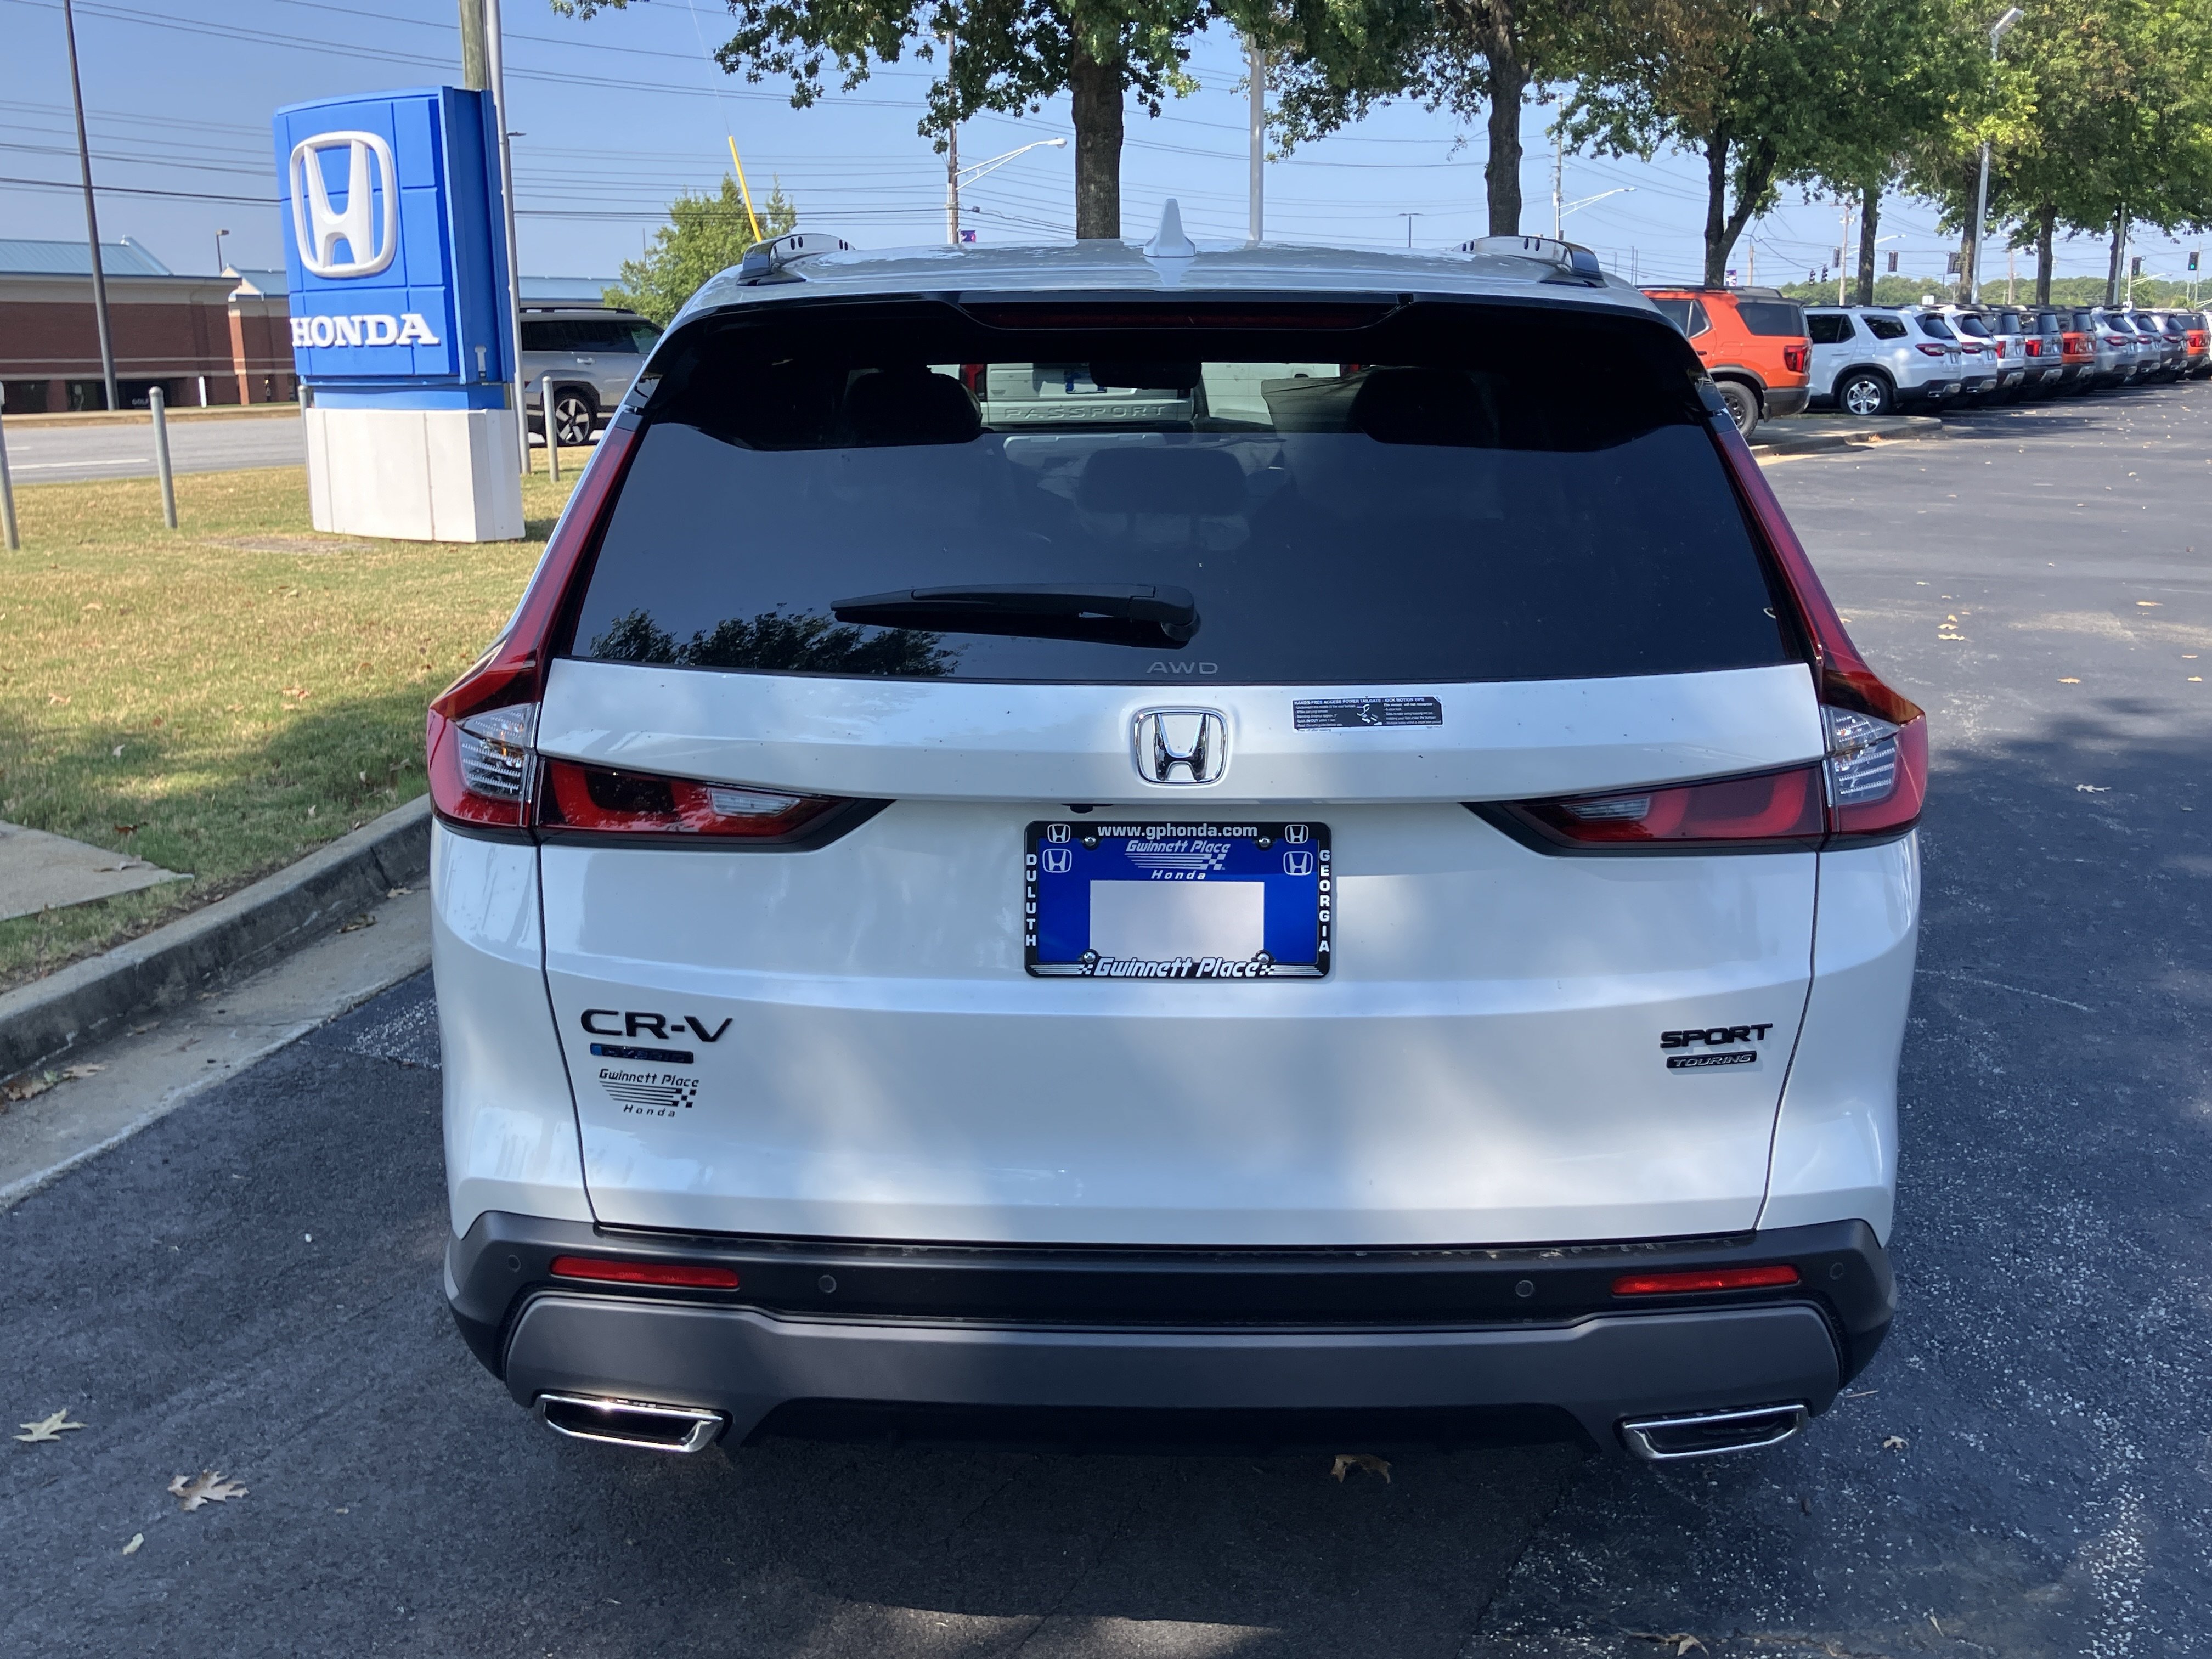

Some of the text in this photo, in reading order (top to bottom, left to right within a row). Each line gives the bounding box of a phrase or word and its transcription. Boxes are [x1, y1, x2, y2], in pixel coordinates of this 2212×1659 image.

[290, 313, 441, 347] HONDA
[1005, 405, 1166, 419] PASSPORT
[1146, 662, 1218, 674] AWD
[1097, 823, 1257, 840] www.gphonda.com
[1126, 840, 1231, 853] Gwinnett Place
[1151, 870, 1206, 880] Honda
[1025, 854, 1037, 947] DULUTH
[1318, 849, 1331, 953] GEORGIA
[1094, 956, 1260, 978] Gwinnett Place
[580, 1008, 733, 1042] CR-V
[1660, 1023, 1773, 1048] SPORT
[1673, 1053, 1753, 1067] TOURING
[599, 1068, 699, 1087] Gwinnett Place
[623, 1104, 676, 1118] Honda
